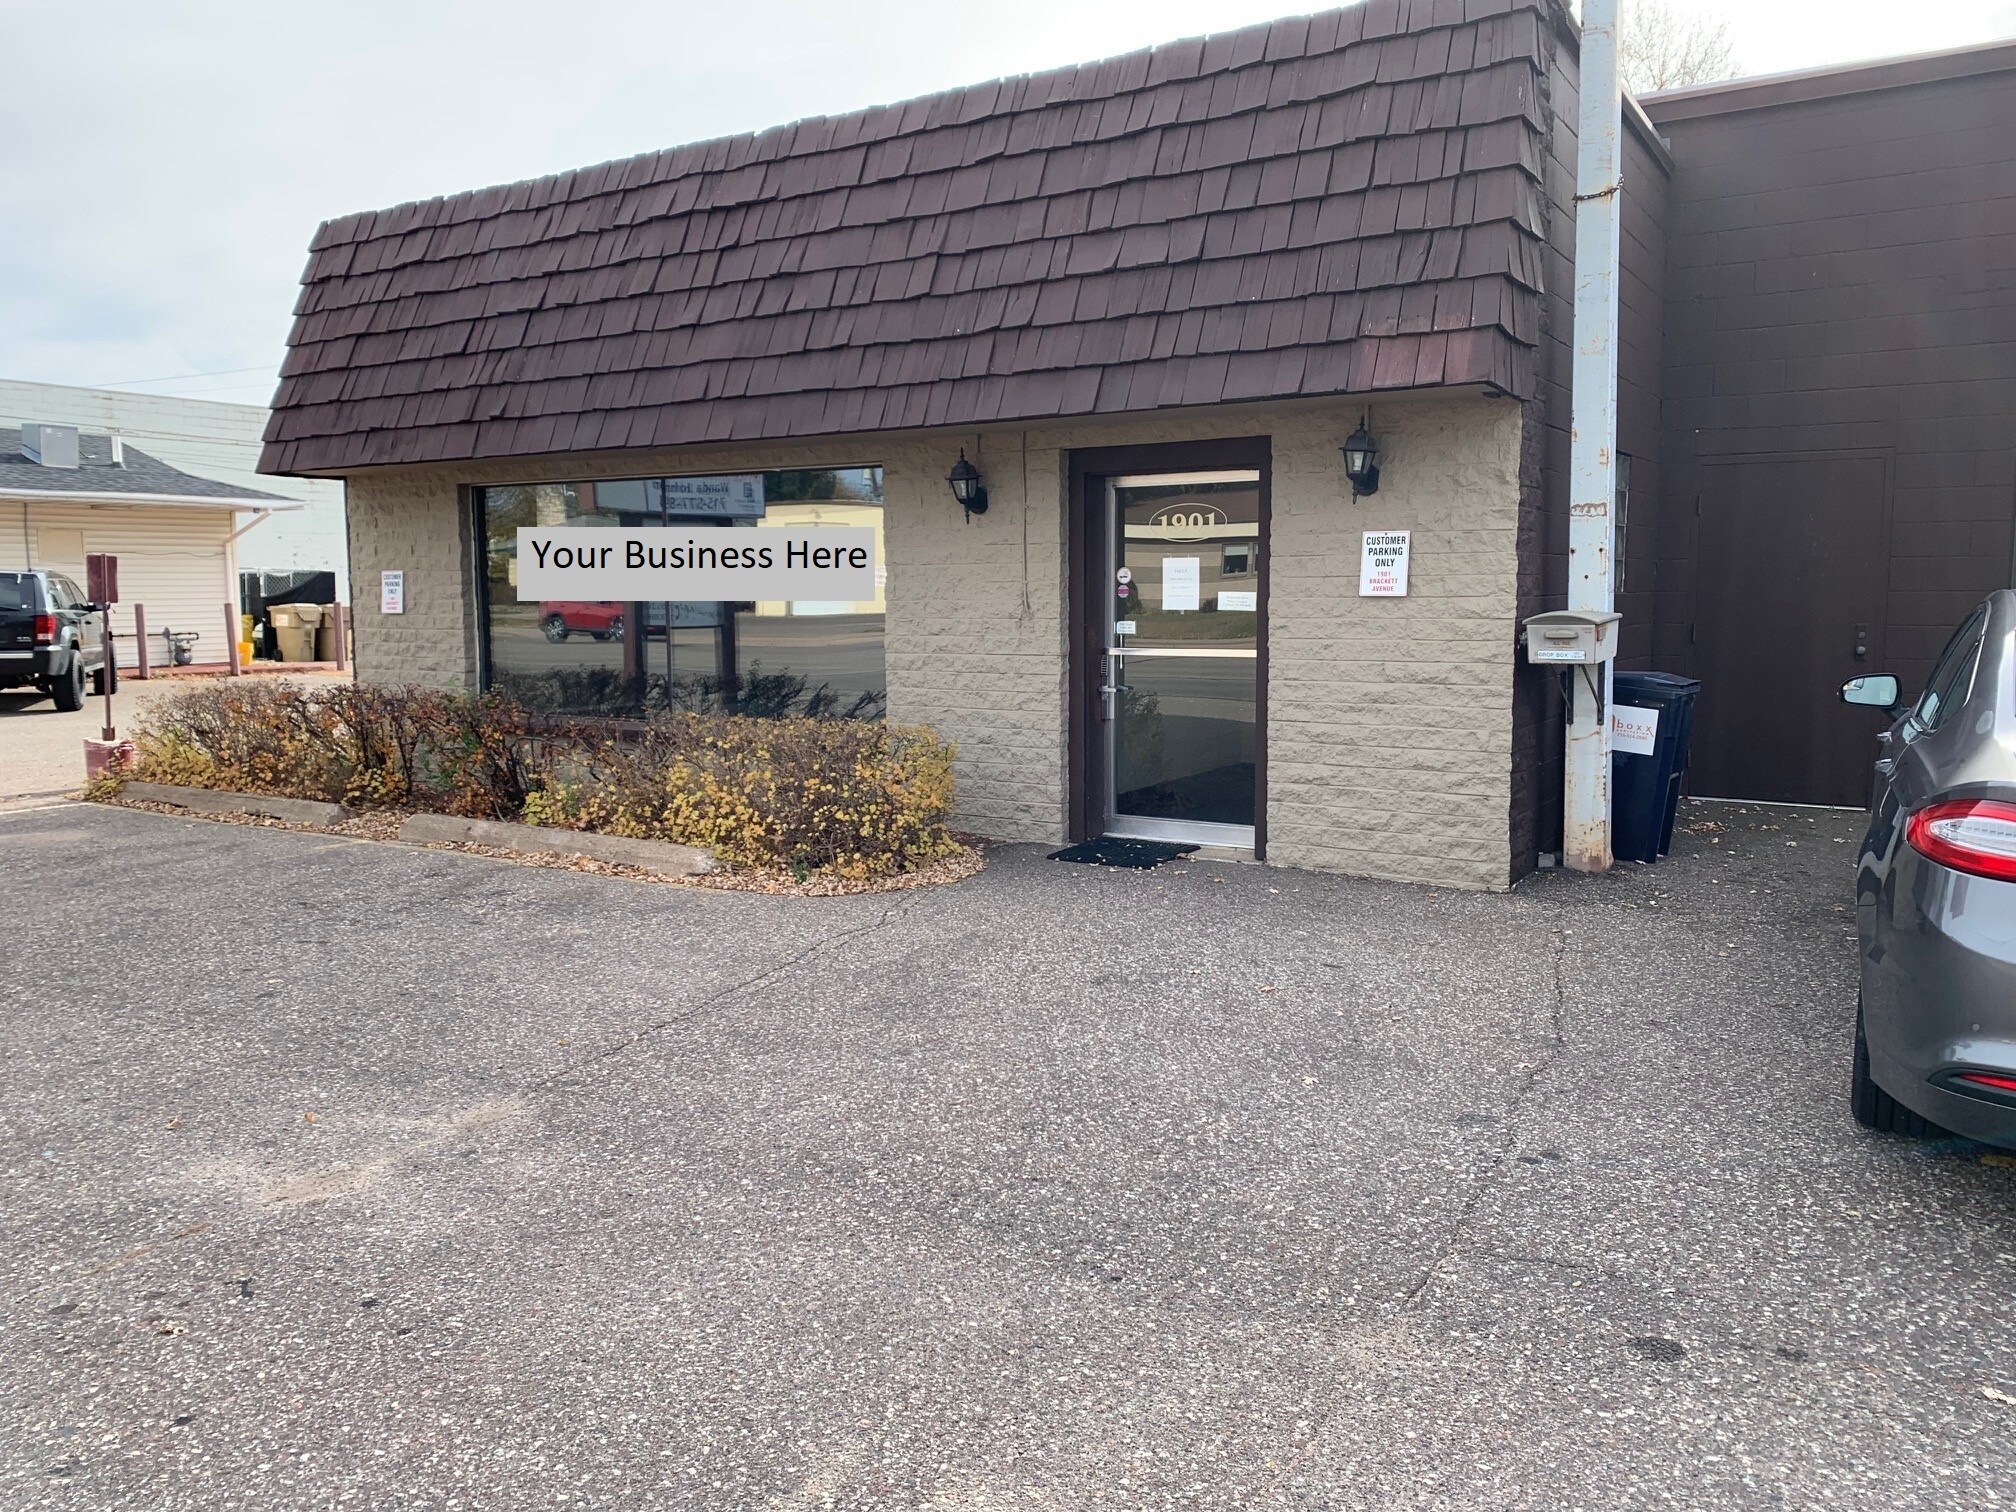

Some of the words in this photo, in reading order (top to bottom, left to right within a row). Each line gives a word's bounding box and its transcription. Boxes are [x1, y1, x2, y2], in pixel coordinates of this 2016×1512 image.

[1157, 512, 1218, 532] 1901
[1366, 536, 1406, 545] CUSTOMER
[1368, 547, 1403, 556] PARKING
[1374, 558, 1395, 567] ONLY
[1617, 718, 1654, 737] boxx
